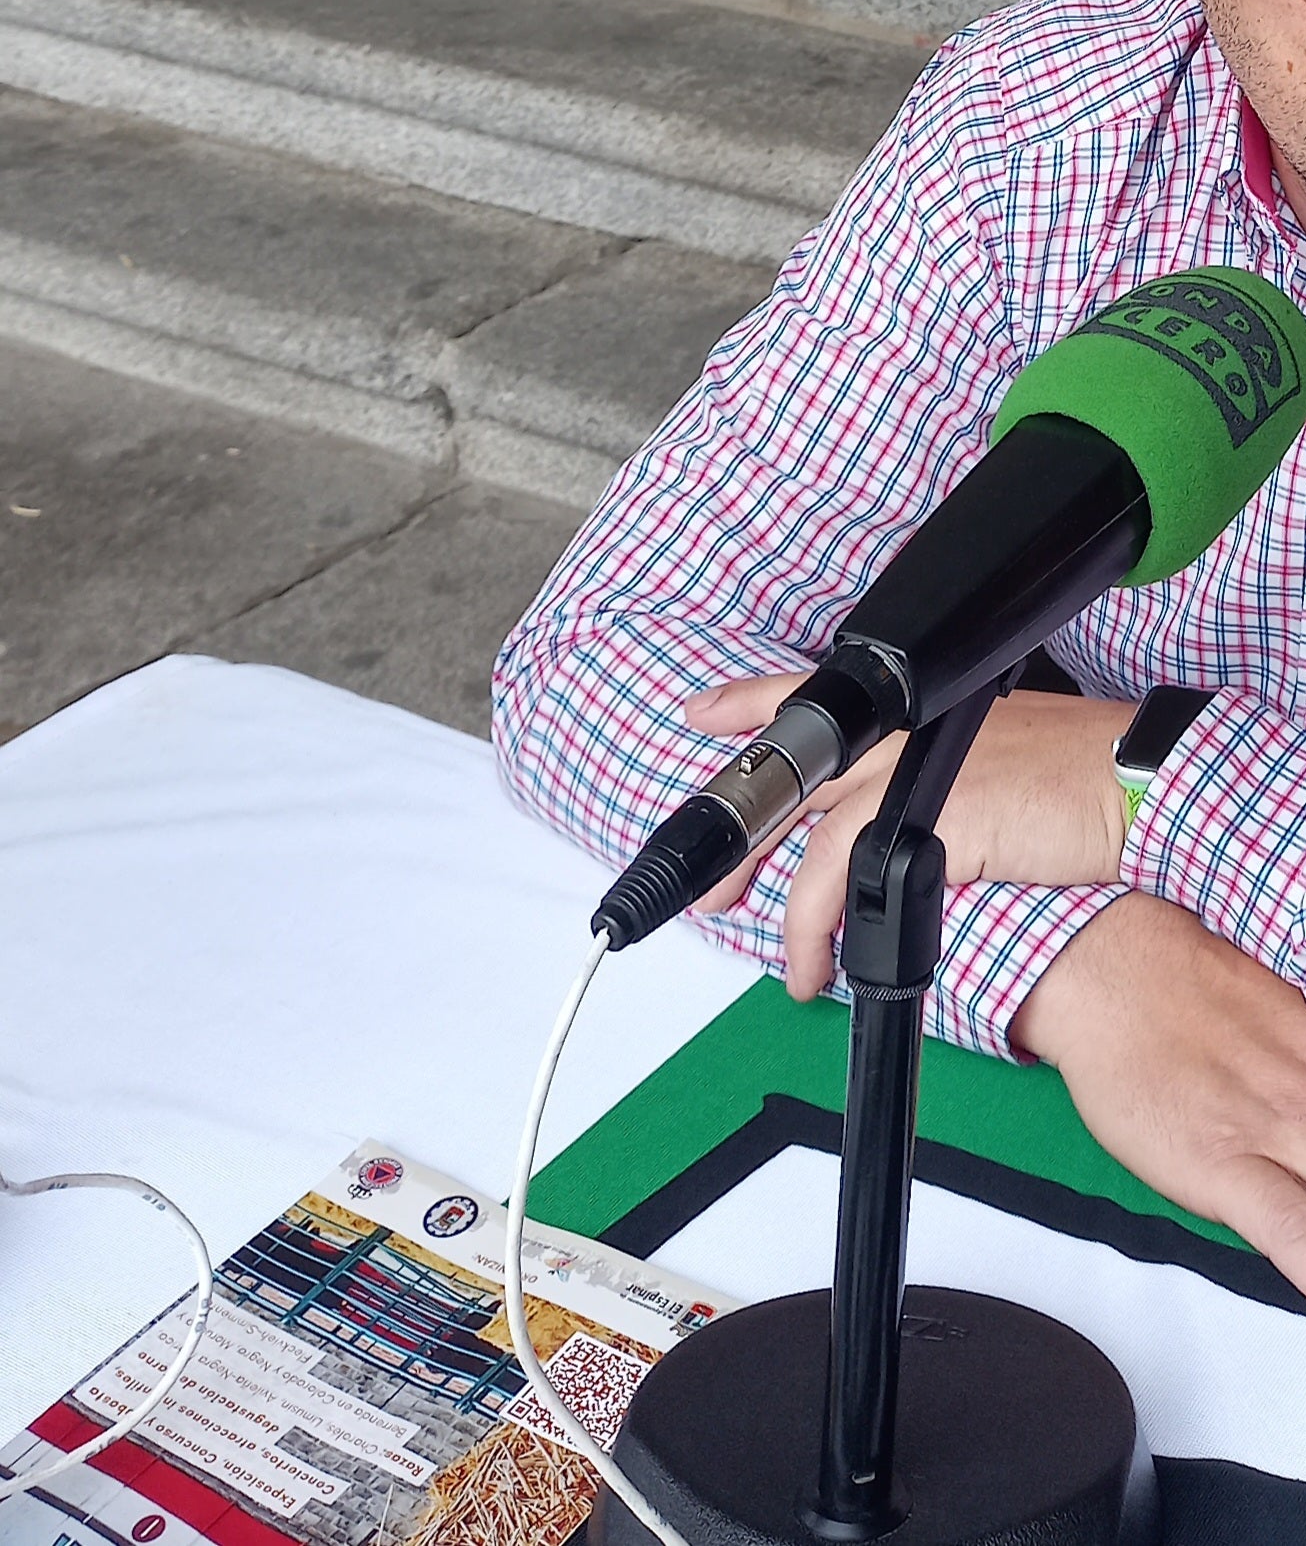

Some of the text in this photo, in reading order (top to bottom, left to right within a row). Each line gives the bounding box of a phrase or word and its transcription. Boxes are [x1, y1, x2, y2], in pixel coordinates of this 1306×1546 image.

[1148, 284, 1276, 373] ONDA
[1123, 307, 1248, 397] CERO
[174, 1309, 186, 1320] y
[624, 1282, 684, 1314] El Espinar
[184, 1317, 234, 1350] Morua
[271, 1363, 283, 1374] y
[136, 1349, 280, 1435] degustación de arne
[279, 1370, 336, 1405] Colorado
[336, 1397, 352, 1411] en
[112, 1365, 336, 1495] Conciertos, atracciones inntiles,
[352, 1408, 407, 1439] Berrenda
[86, 1385, 297, 1510] Exposición, Concurso y ubasta
[379, 1447, 424, 1478] Razas:
